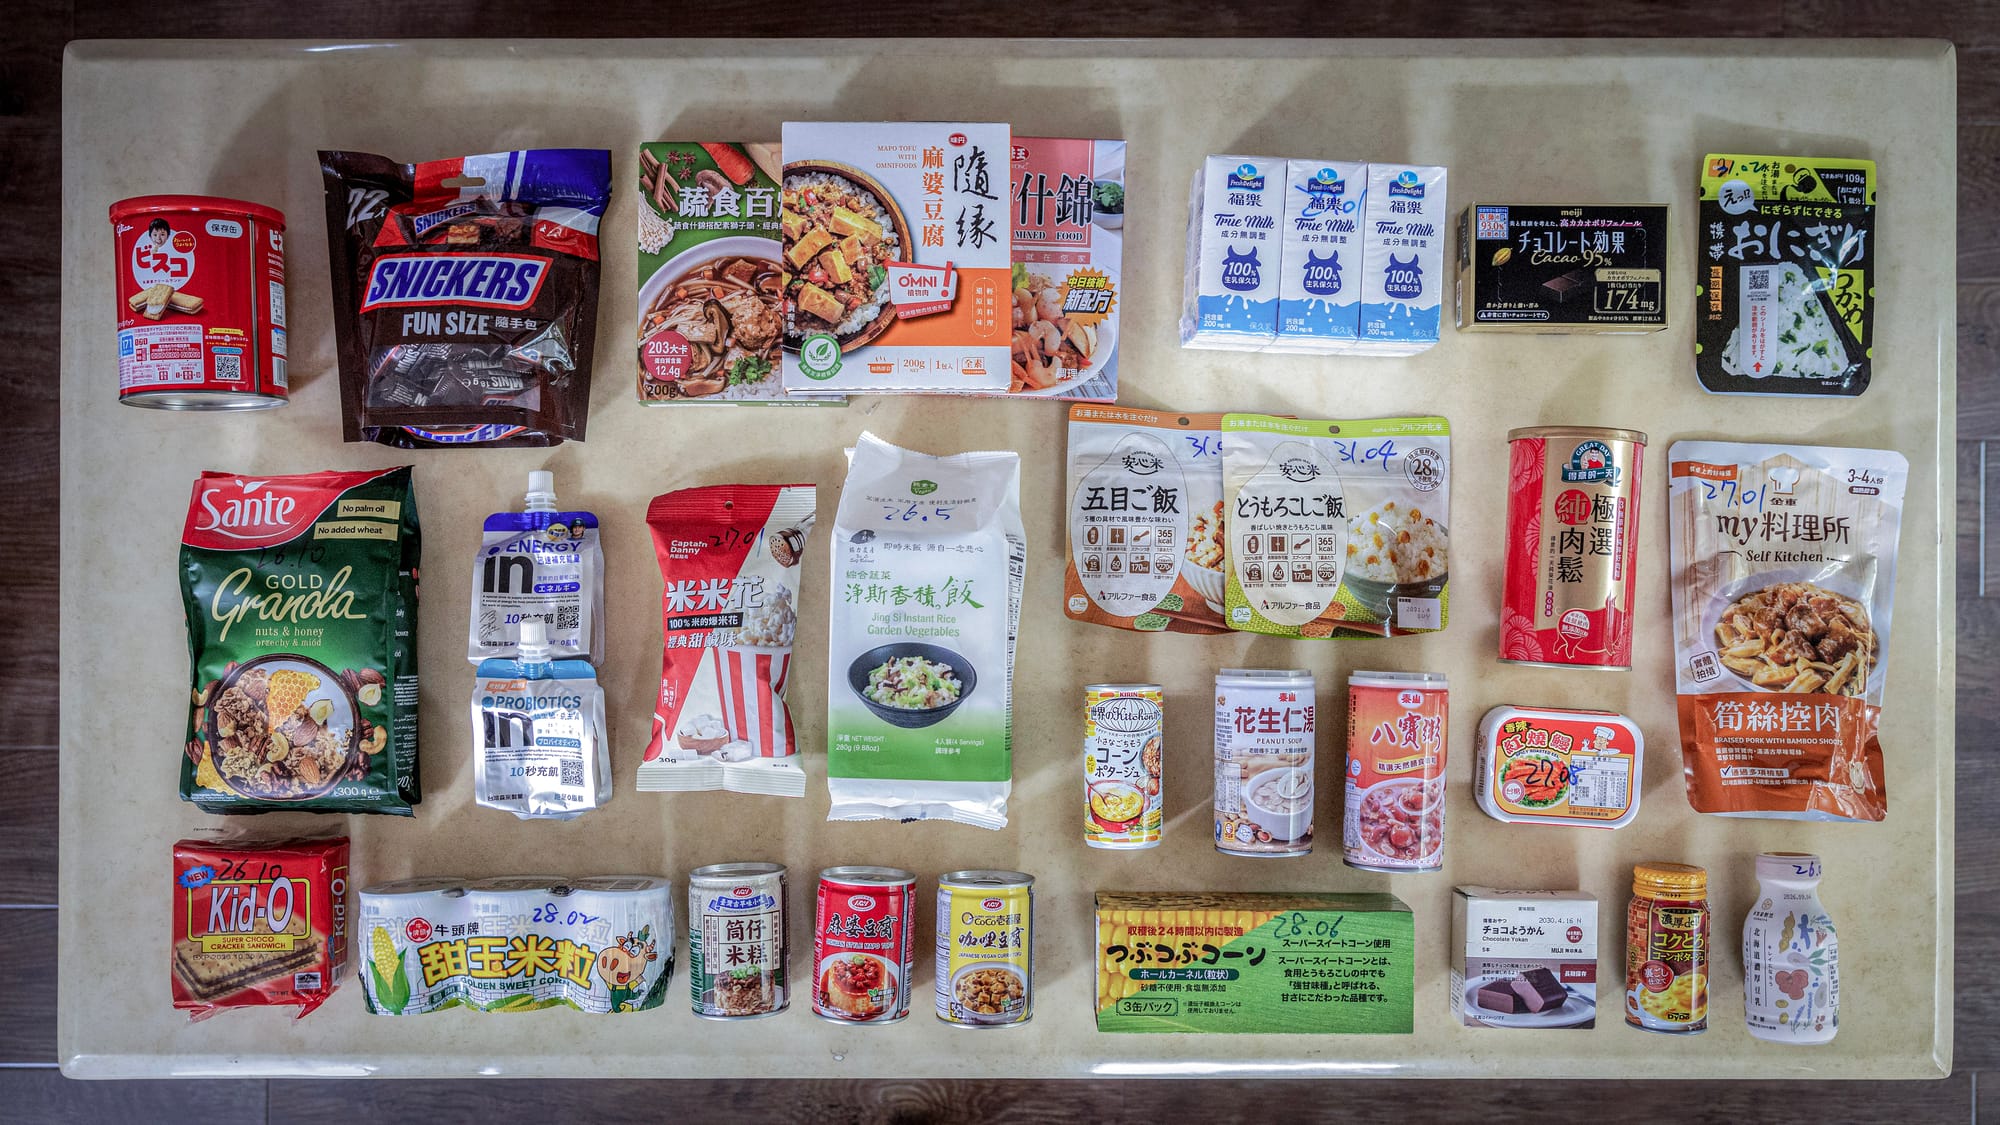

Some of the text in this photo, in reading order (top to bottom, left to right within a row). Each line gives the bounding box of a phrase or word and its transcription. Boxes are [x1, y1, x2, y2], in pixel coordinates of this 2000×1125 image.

[877, 144, 917, 152] MAPO TOFU
[897, 153, 917, 161] WITH
[678, 186, 783, 218] 蔬食百
[921, 145, 945, 248] 麻婆豆腐
[952, 145, 1000, 250] 隨緣
[1227, 192, 1264, 208] 福樂
[1389, 200, 1424, 215] 福樂
[1560, 208, 1583, 218] meiji
[1760, 205, 1843, 219] にぎらずにできる
[415, 202, 477, 235] SNICKERS
[1213, 213, 1275, 230] True Milk
[1294, 217, 1356, 233] True Milk
[211, 223, 237, 234] 保存缶
[1015, 231, 1084, 241] MIXED FOOD
[1220, 230, 1267, 241] 成分無調整
[1375, 221, 1435, 238] True Milk
[1302, 234, 1348, 245] 成分無調整
[1383, 237, 1428, 248] 成分無調整
[1518, 230, 1626, 254] チョコレート効果
[1728, 220, 1868, 267] おにぎり
[136, 244, 188, 278] ビスコ
[1530, 249, 1581, 267] Cacao
[1226, 262, 1257, 277] 100%
[1308, 265, 1339, 282] 100%
[1389, 269, 1420, 285] 100%
[368, 258, 540, 304] SNICKERS
[1224, 276, 1259, 286] 生乳保久乳
[1305, 279, 1340, 290] 生乳保久乳
[1386, 283, 1421, 294] 生乳保久乳
[1062, 289, 1114, 314] 新配方
[402, 310, 489, 337] FUN SIZE
[495, 316, 538, 331] 隨手包
[1575, 442, 1599, 457] GREAT
[1121, 454, 1165, 470] 安心米
[1279, 462, 1321, 477] 安心米
[1412, 458, 1433, 477] 28
[1567, 468, 1615, 482] 得意的一天
[1080, 484, 1181, 515] 五目ご飯
[1700, 480, 1767, 513] 27.01
[1769, 497, 1798, 507] 金車
[342, 504, 385, 514] No palm oil
[883, 503, 956, 521] 26.5
[1237, 493, 1346, 519] とうもろこしご飯
[318, 526, 383, 535] No added wheat
[1250, 523, 1334, 532] 香ばしい焼きとうもろこし風味
[1588, 493, 1615, 556] 極選
[1157, 529, 1173, 538] 365
[505, 539, 582, 554] ENERGY
[671, 539, 708, 548] Captain
[1317, 537, 1333, 546] 365
[670, 547, 701, 555] Danny
[1745, 550, 1824, 563] Self Kitchen
[265, 574, 323, 590] GOLD
[483, 555, 535, 594] in
[538, 585, 577, 593] エネルギー
[666, 575, 765, 613] 米米花
[211, 565, 367, 642] Granola
[1106, 592, 1157, 602] アルファー食品
[1270, 600, 1321, 611] アルファー食品
[871, 612, 957, 624] Jing Si Instant Rice
[255, 626, 324, 638] nuts & honey
[867, 624, 960, 638] Garden Vegetables
[495, 695, 582, 711] PROBIOTICS
[1278, 692, 1297, 702] 泰山
[1400, 693, 1421, 705] 泰山
[1234, 705, 1315, 735] 花生仁湯
[1713, 700, 1841, 733] 筍絲控肉
[482, 711, 536, 749] in
[1371, 712, 1442, 752] 八寶粥
[1504, 721, 1528, 733] 香辣
[863, 735, 885, 743] WEIGHT
[1256, 737, 1286, 745] PEANUT
[1503, 730, 1574, 754] 紅燒鰻
[1714, 736, 1818, 746] BRAISED PORK WITH BAMBOO
[1096, 747, 1139, 766] コーン
[509, 766, 560, 778] 10秒充飢
[1094, 764, 1141, 779] ポタージュ
[185, 870, 210, 883] NEW
[207, 876, 295, 934] Kid-O
[330, 878, 347, 937] Kid-O
[532, 902, 600, 926] 28.02
[434, 922, 480, 937] 牛頭牌
[725, 918, 767, 942] 筒仔
[825, 912, 898, 940] 麻婆豆腐
[1127, 926, 1244, 937] 収穫後24時間以内に製造
[1272, 911, 1344, 939] 28.06
[1482, 925, 1545, 936] チョコようかん
[958, 926, 1025, 949] 咖哩豆腐
[1282, 938, 1391, 949] スーパースイートコーン使用
[1653, 931, 1705, 950] コクとろ
[417, 933, 597, 990] 甜玉米粒
[725, 944, 768, 967] 米糕
[1106, 941, 1267, 967] つぶつぶコーン
[1278, 956, 1392, 967] スーパースイートコーンとは、
[1140, 969, 1230, 981] ホールカーネル(粒状)
[1283, 968, 1387, 979] 食用とうもろこしの中でも
[460, 976, 498, 991] GOLDEN
[499, 978, 537, 991] SWEET
[1281, 992, 1389, 1004] 甘さにこだわった品種です。
[1123, 1001, 1173, 1014] 3缶パック
[1667, 1011, 1690, 1021] DyDo
